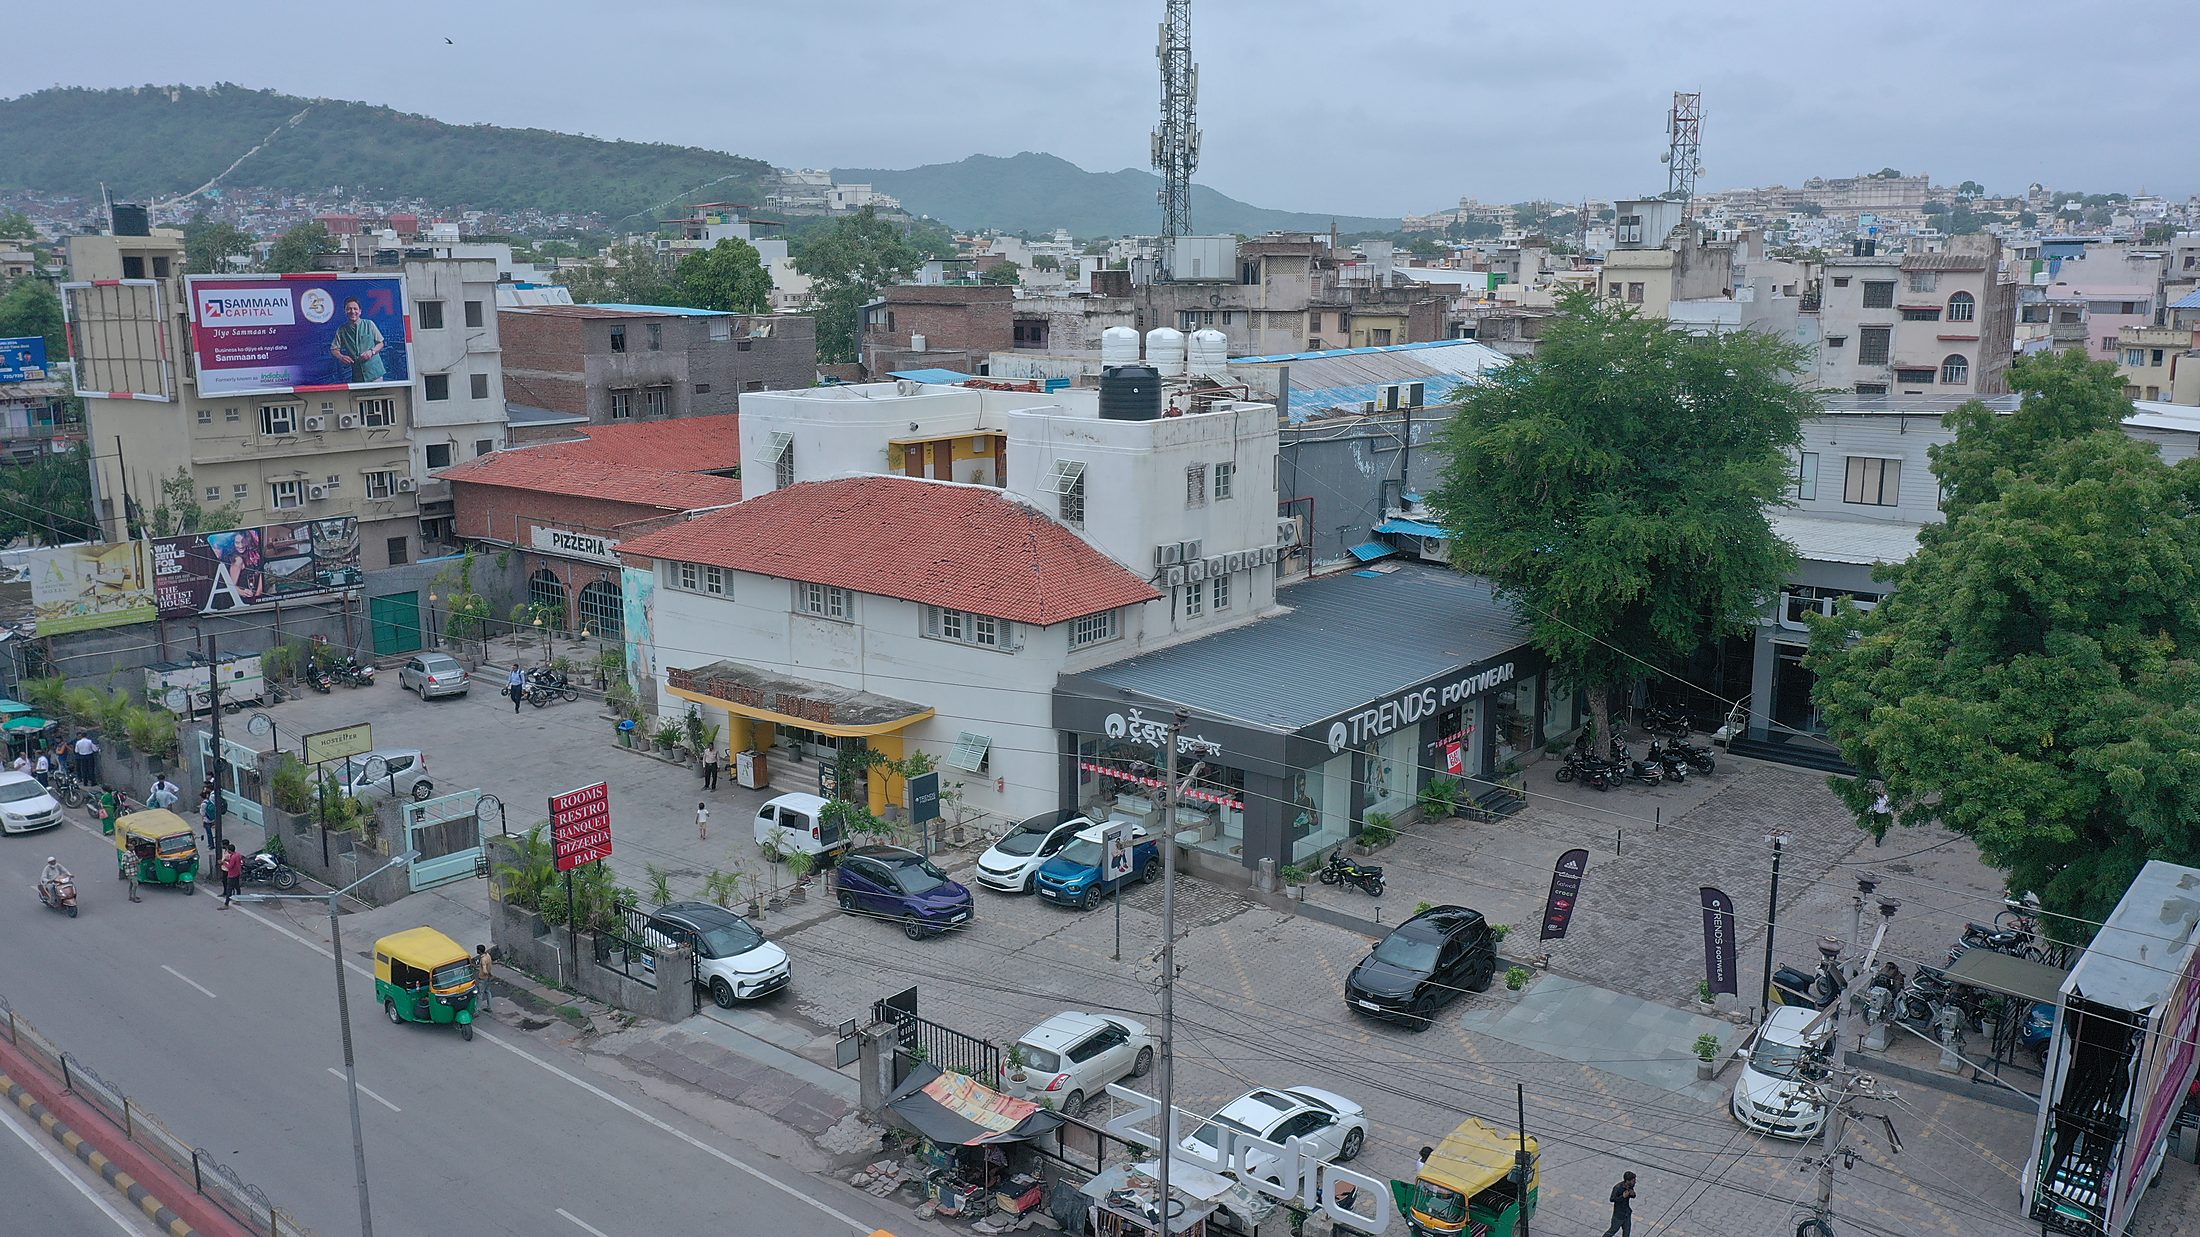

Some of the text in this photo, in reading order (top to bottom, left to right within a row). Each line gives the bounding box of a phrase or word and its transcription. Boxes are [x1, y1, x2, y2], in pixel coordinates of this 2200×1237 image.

[224, 298, 288, 308] SAMMAAN
[225, 308, 273, 317] CAPITAL
[231, 328, 267, 336] Sammaan
[268, 327, 277, 335] Se
[215, 352, 269, 362] Sammaan se!
[154, 543, 177, 554] WHY
[552, 532, 606, 556] PIZZERIA
[155, 550, 186, 561] SETTLE
[155, 559, 176, 569] FOR
[156, 565, 183, 576] LESS?
[157, 585, 175, 595] THE
[160, 590, 194, 602] ARTIST
[160, 597, 193, 609] HOUSE
[775, 692, 838, 726] HOUSE
[1348, 686, 1437, 745] TRENDS
[1441, 662, 1515, 707] FOOTWEAR
[560, 786, 603, 809] ROOMS
[559, 801, 606, 825] RESTRO
[559, 814, 608, 839] BANQUET
[560, 831, 609, 855] PIZZERIA
[574, 849, 598, 865] BAR
[1554, 889, 1574, 897] crocs
[1713, 907, 1723, 982] TRENDS FOOTWEAR
